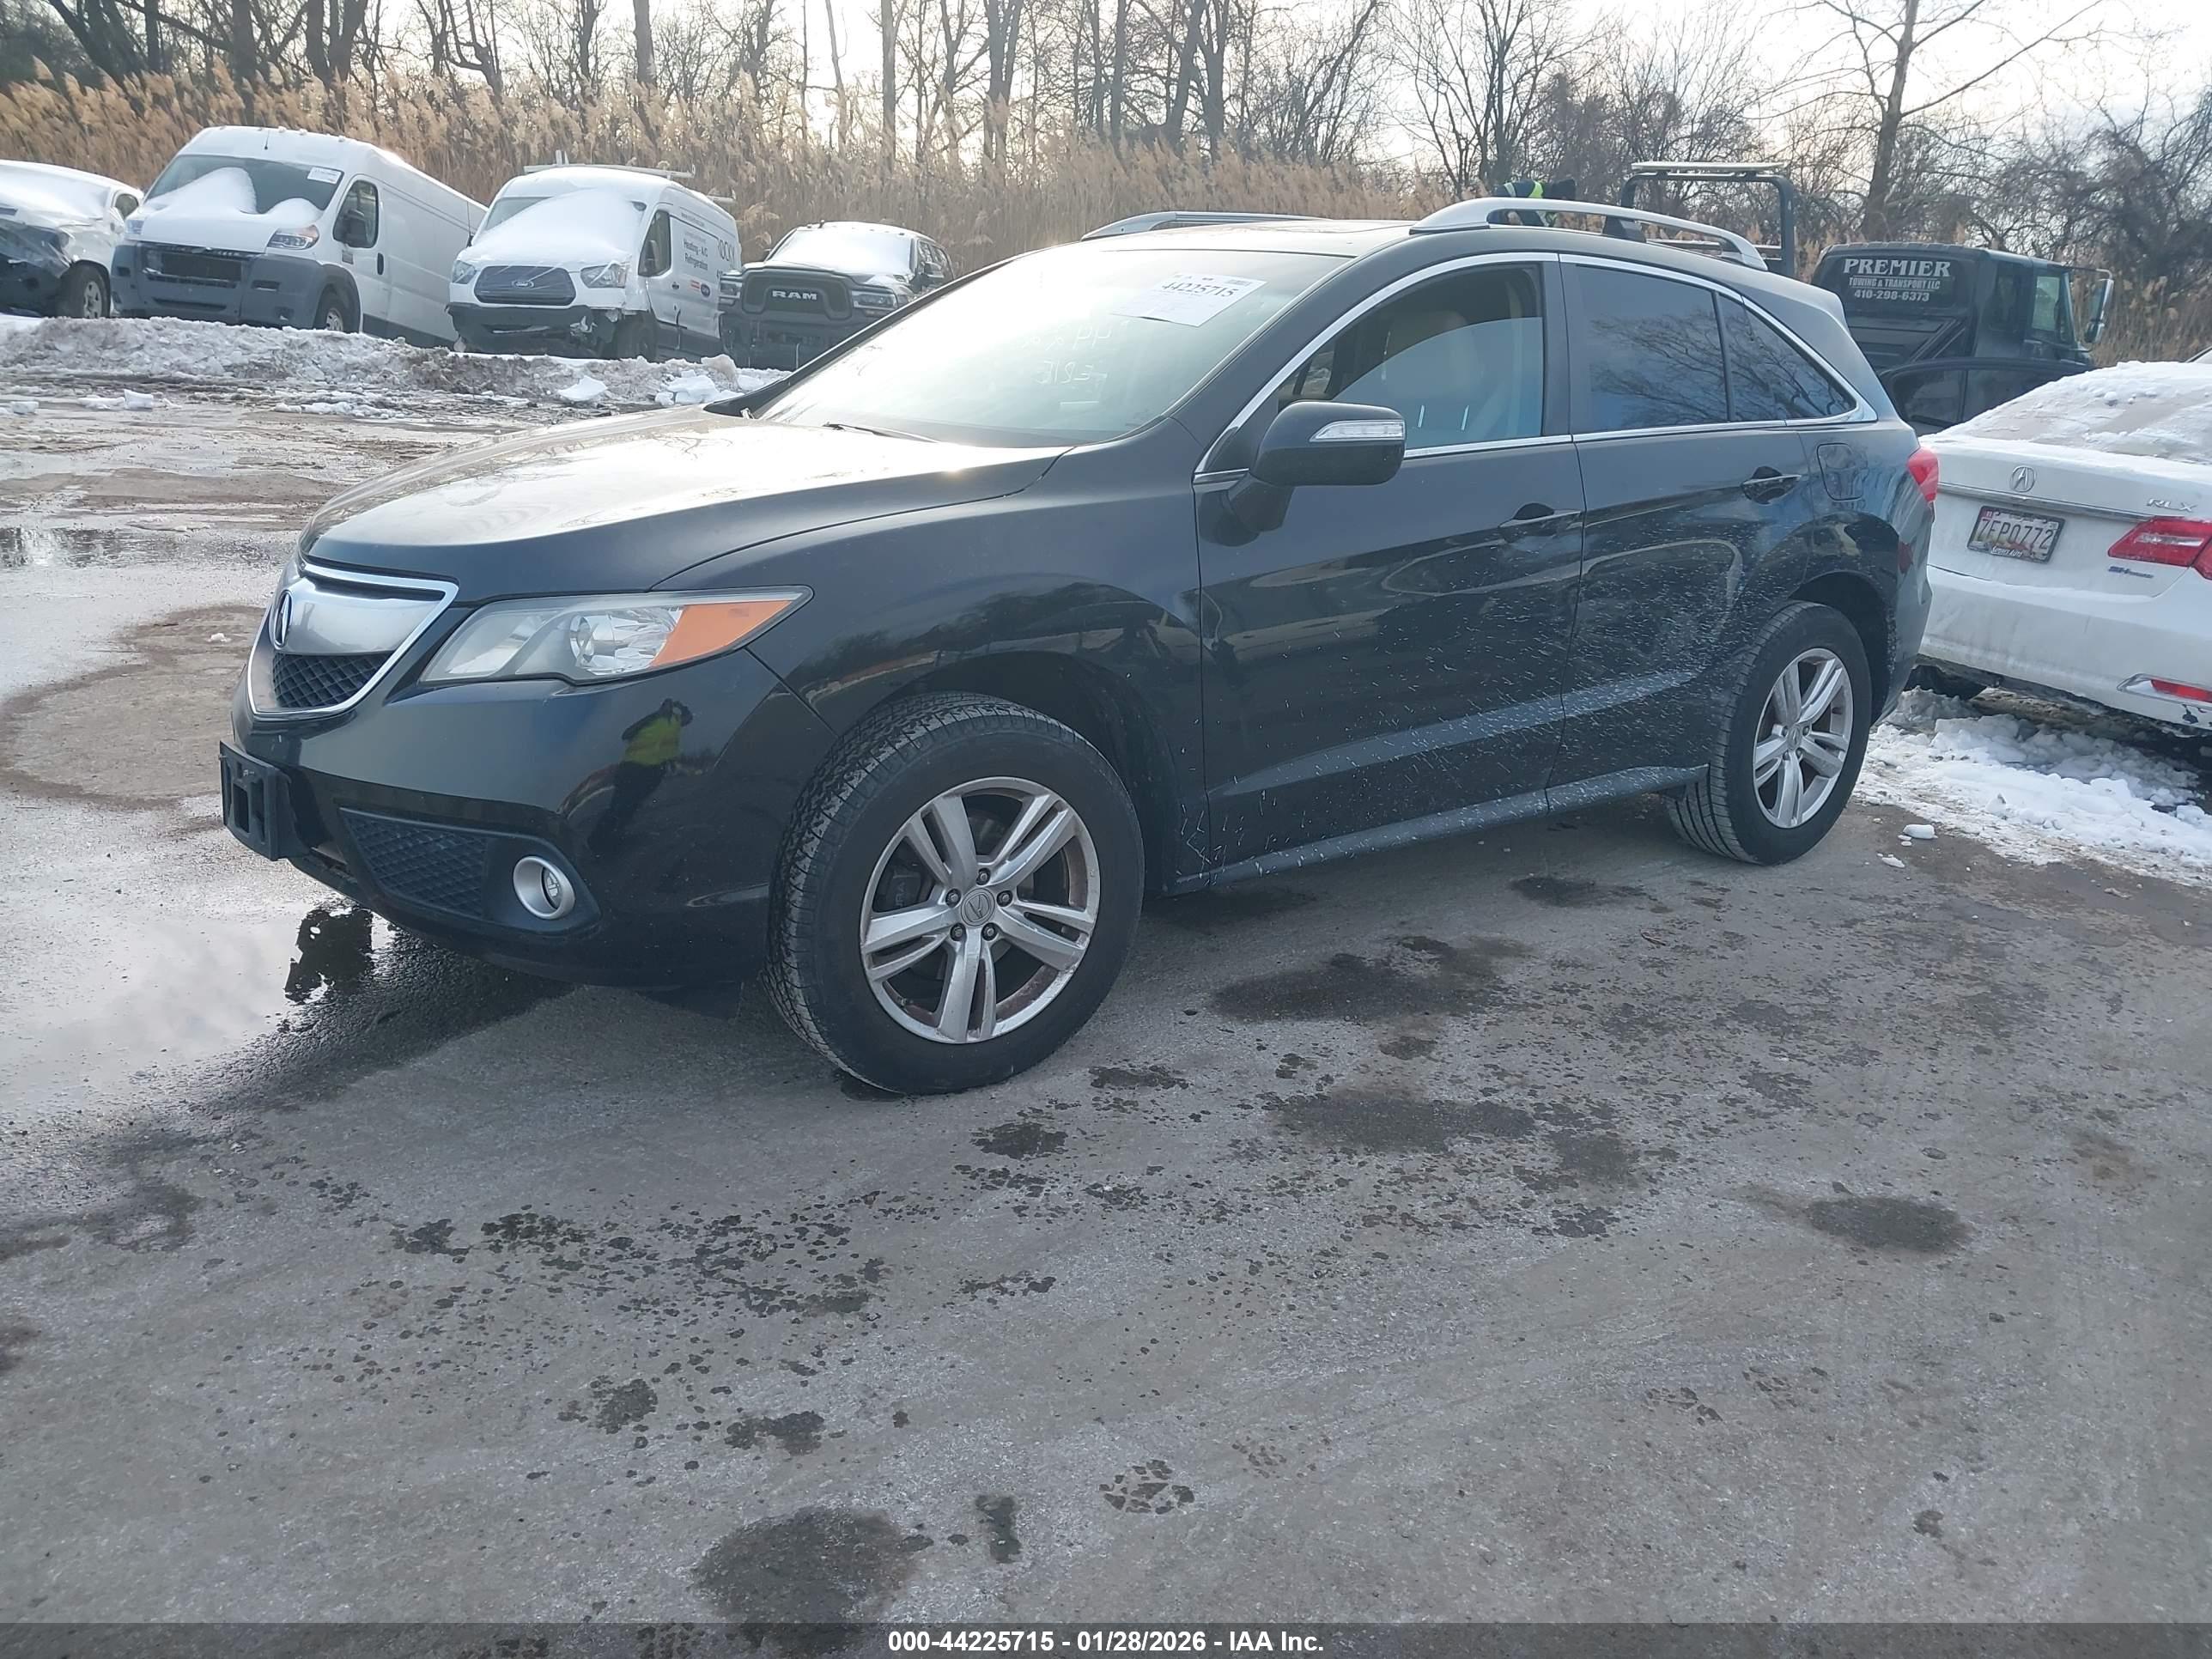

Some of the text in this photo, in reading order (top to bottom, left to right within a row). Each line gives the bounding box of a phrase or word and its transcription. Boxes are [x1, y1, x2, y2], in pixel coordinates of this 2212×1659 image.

[1843, 258, 1951, 276] PREMIER
[1162, 282, 1239, 297] 44225715
[1849, 276, 1877, 287] TOWING
[1885, 278, 1927, 289] TRANSPORT
[1927, 280, 1941, 290] LLC
[772, 290, 817, 301] RAM
[1854, 289, 1930, 302] 410-298-6373
[2147, 498, 2198, 513] RLX
